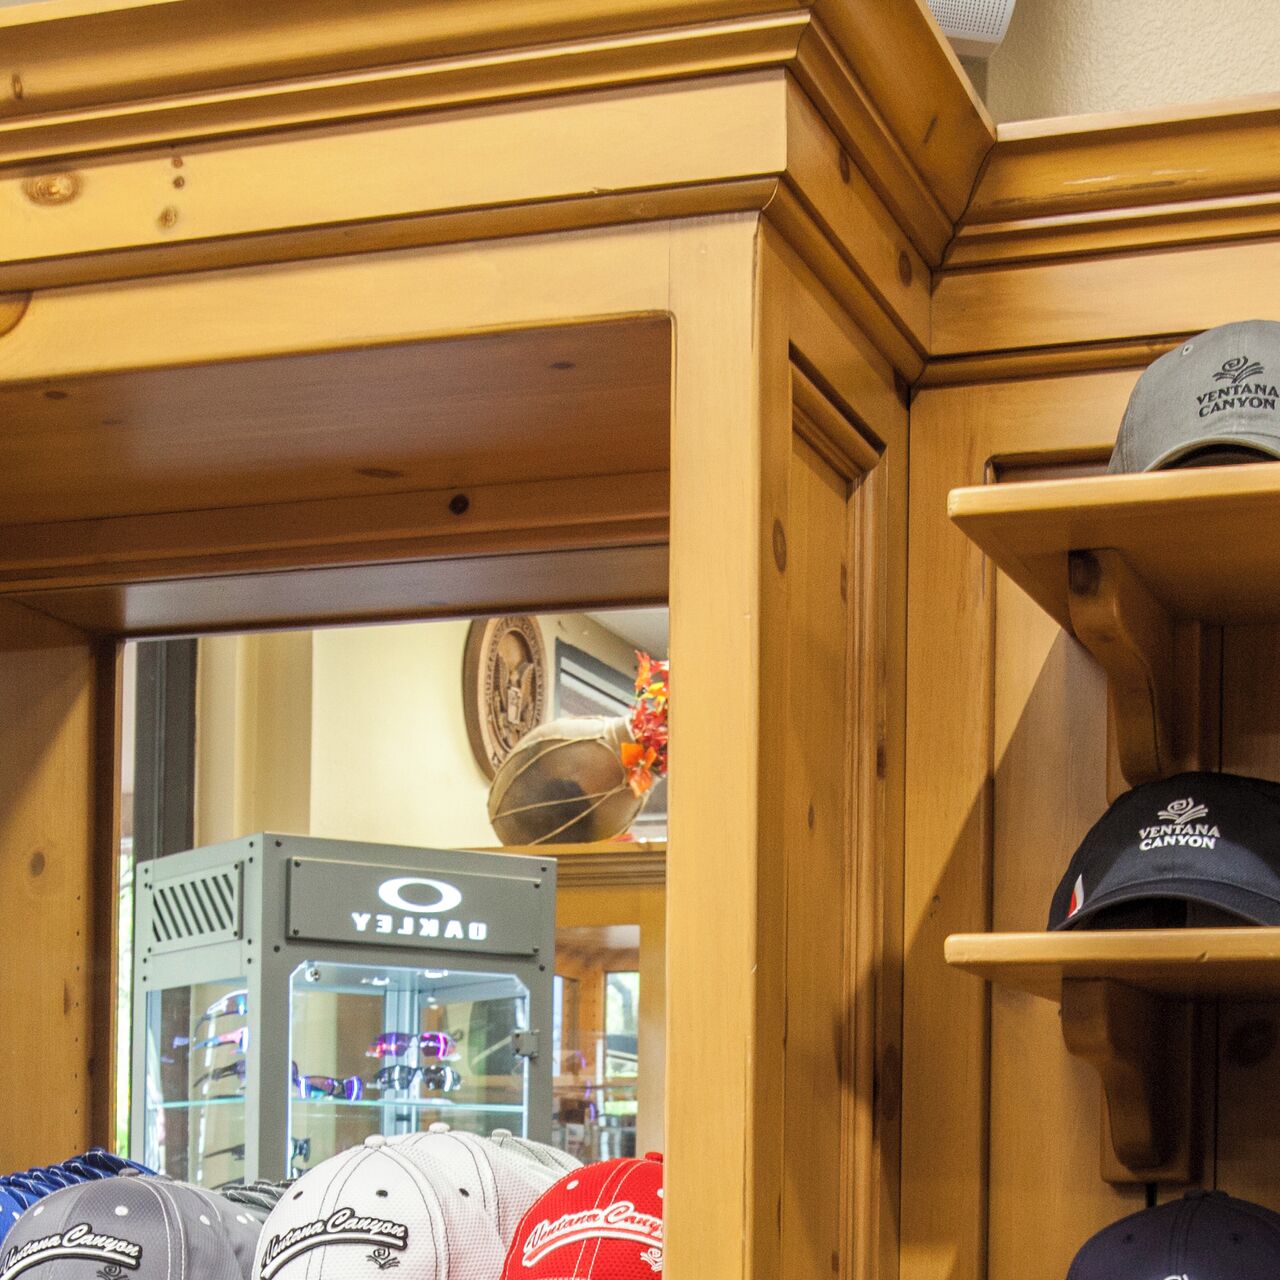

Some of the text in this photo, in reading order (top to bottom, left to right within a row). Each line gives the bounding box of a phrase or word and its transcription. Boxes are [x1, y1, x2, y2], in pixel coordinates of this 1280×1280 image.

[1196, 383, 1280, 404] VENTANA
[1198, 396, 1276, 418] CANYON
[1139, 823, 1220, 840] VENTANA
[1139, 835, 1217, 851] CANYON
[325, 1207, 407, 1237] Canyon
[602, 1202, 663, 1236] Cany
[62, 1223, 140, 1257] Canyon
